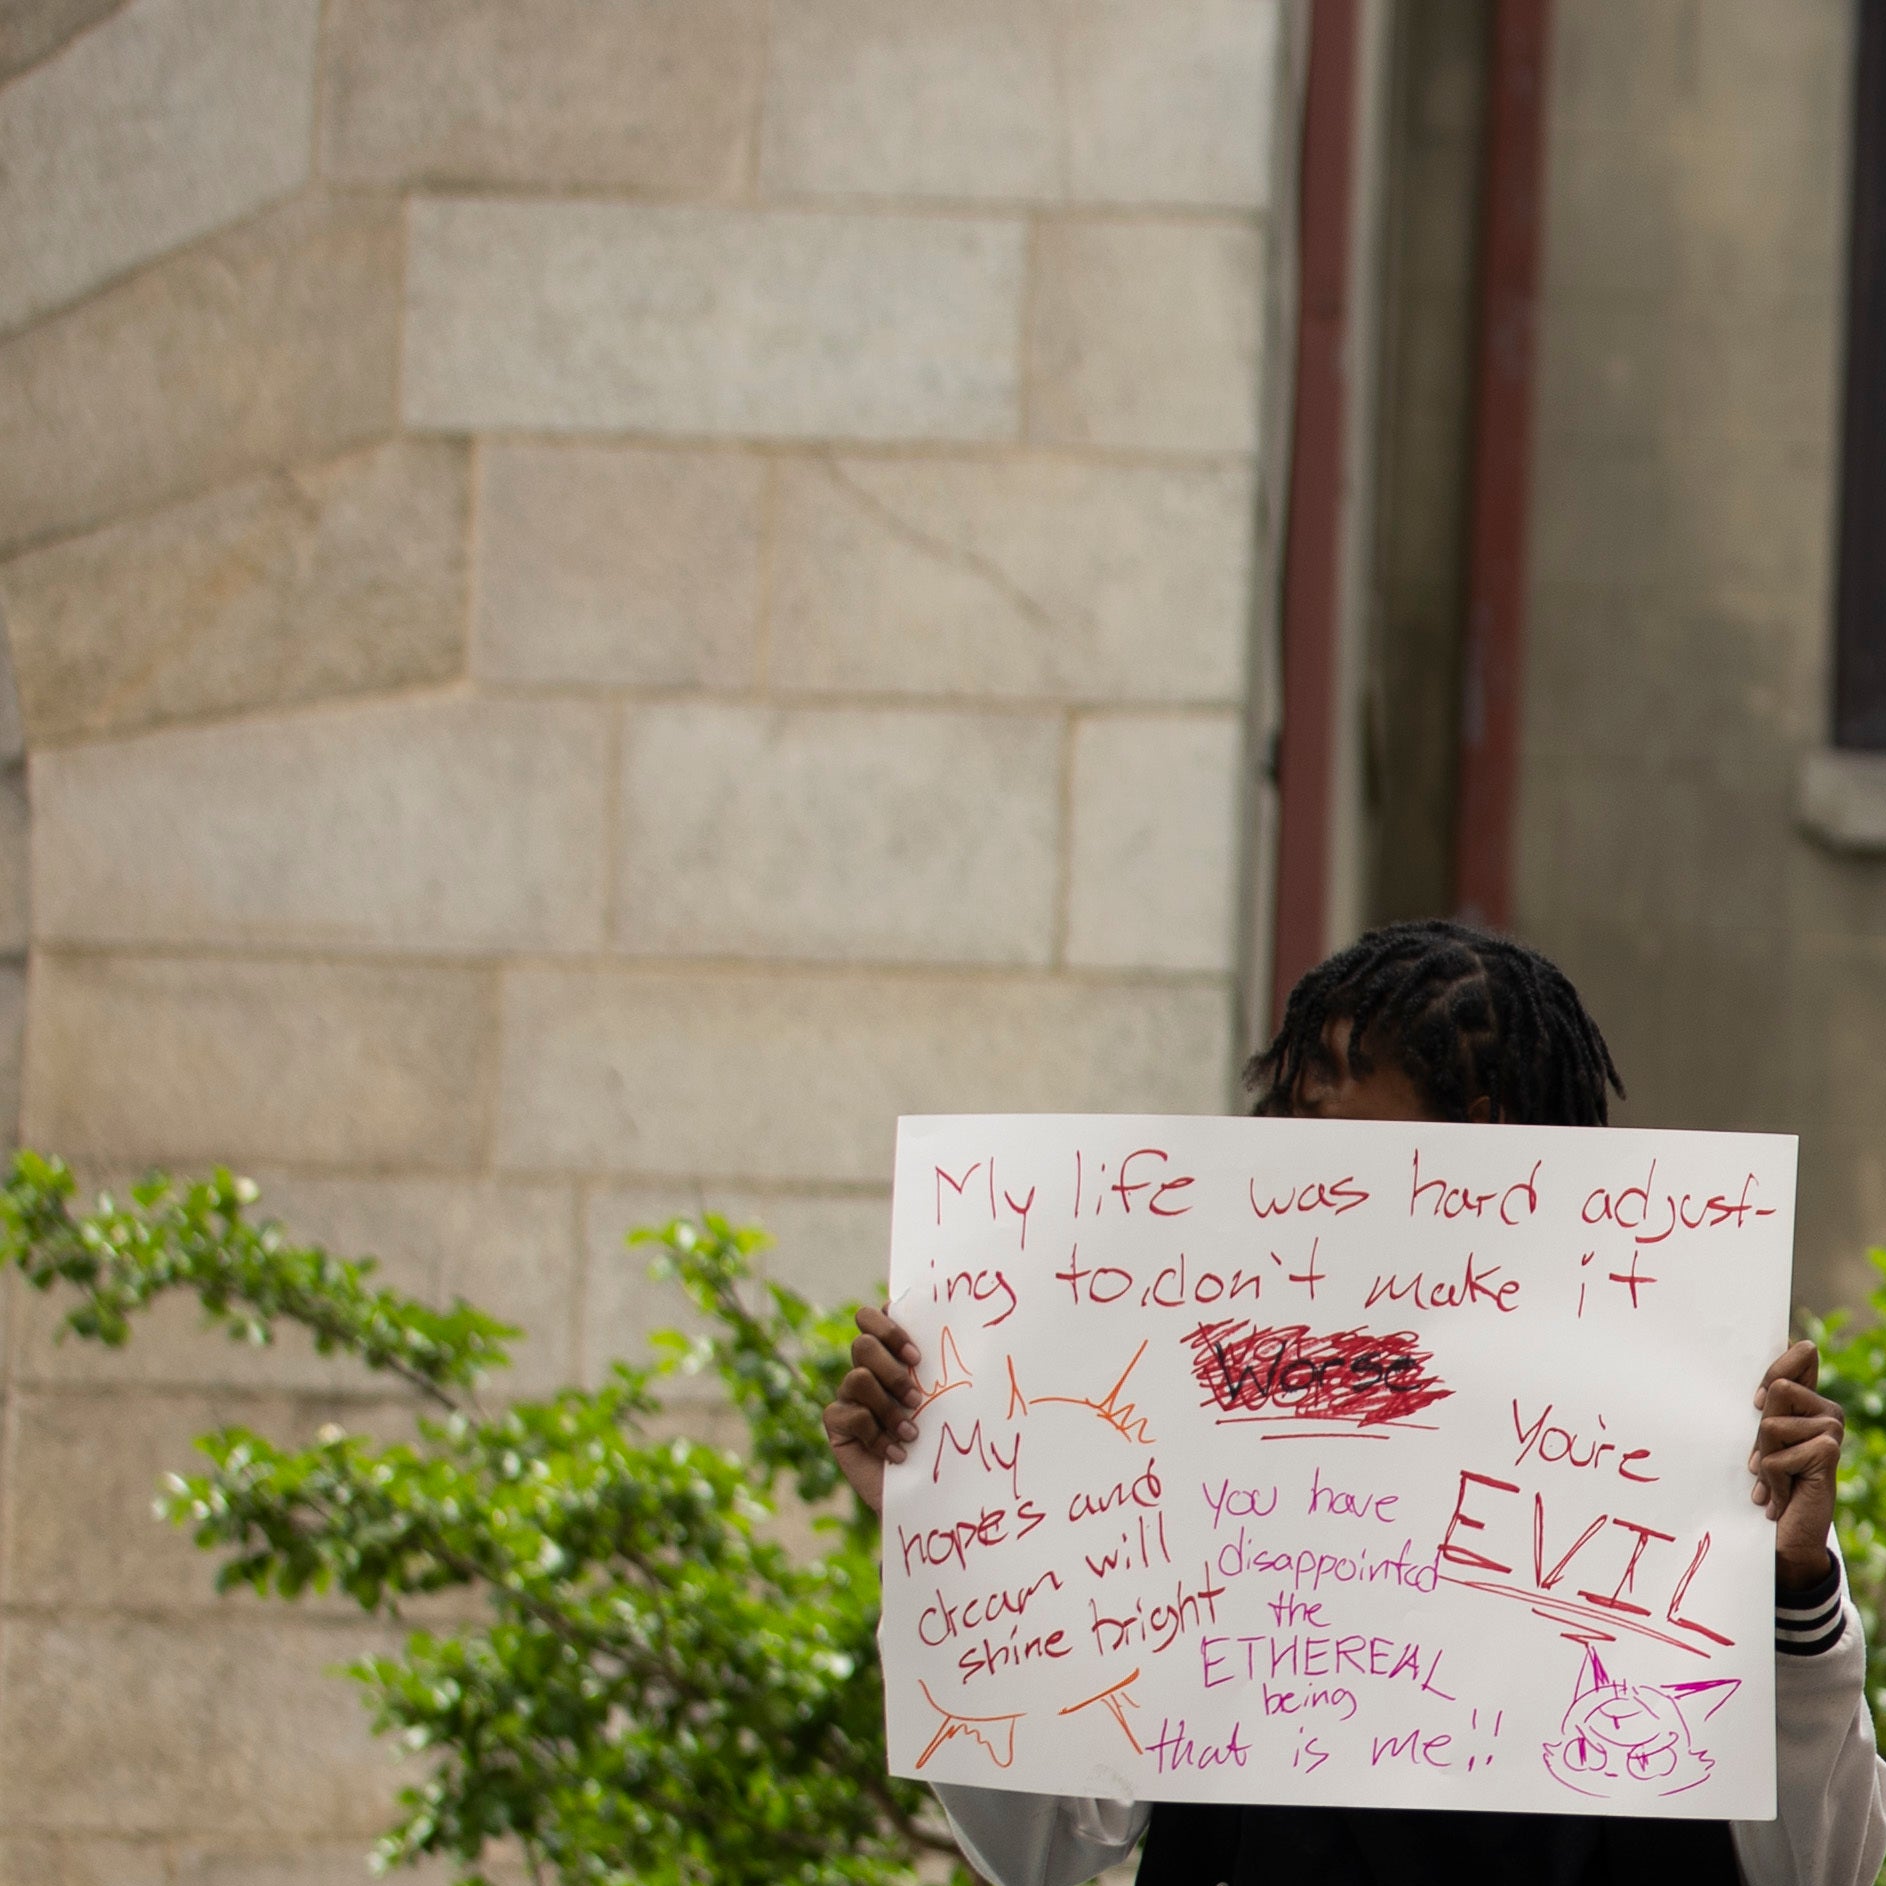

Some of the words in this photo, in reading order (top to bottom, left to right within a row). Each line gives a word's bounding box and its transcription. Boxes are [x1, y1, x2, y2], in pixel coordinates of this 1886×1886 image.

[935, 1156, 1035, 1251] My
[1074, 1148, 1196, 1219] life
[1249, 1175, 1369, 1219] was
[1410, 1148, 1542, 1226] hard
[1581, 1158, 1777, 1245] adjust-
[930, 1259, 1018, 1329] ing
[1364, 1252, 1520, 1312] make
[1577, 1250, 1658, 1319] it
[933, 1419, 1021, 1500] My
[1512, 1398, 1660, 1483] You're
[898, 1500, 1047, 1578] hopes
[1069, 1457, 1161, 1522] and
[1202, 1478, 1278, 1529] you
[1308, 1467, 1399, 1523] have
[1085, 1510, 1171, 1578] will
[1218, 1526, 1441, 1593] disappointed
[1438, 1469, 1735, 1646] EVIL
[958, 1624, 1074, 1685] shine
[1088, 1560, 1226, 1656] bright
[1268, 1590, 1332, 1628] the
[1200, 1634, 1456, 1701] ETHEREAL
[1262, 1682, 1358, 1721] being
[1144, 1717, 1253, 1774] that
[1293, 1726, 1330, 1774] is
